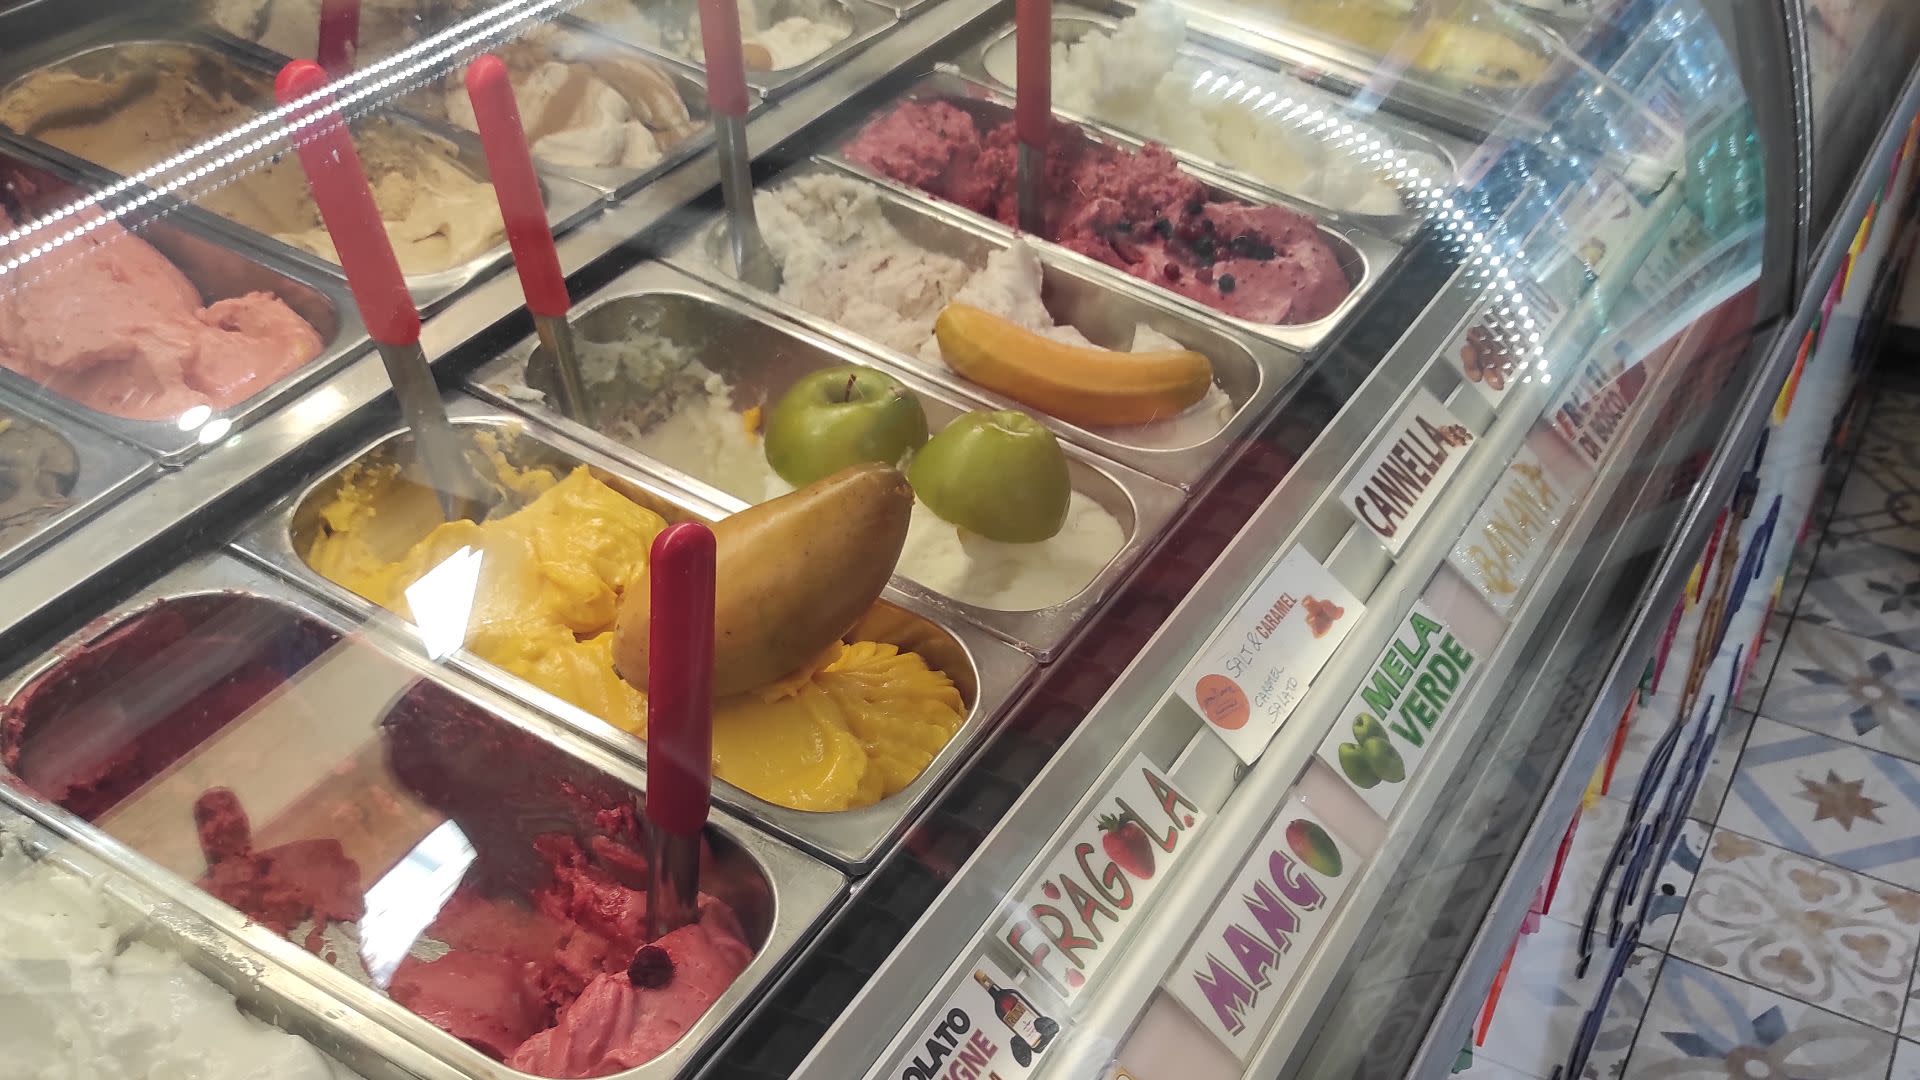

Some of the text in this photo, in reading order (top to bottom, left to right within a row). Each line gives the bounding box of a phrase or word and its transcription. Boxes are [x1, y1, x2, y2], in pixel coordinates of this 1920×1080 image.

[1354, 415, 1452, 538] CANNELLA
[1225, 592, 1298, 679] SALT & CARAMEL
[1361, 611, 1442, 720] MELA
[1389, 632, 1475, 748] VERDE
[1006, 767, 1199, 998] FRAGOLA
